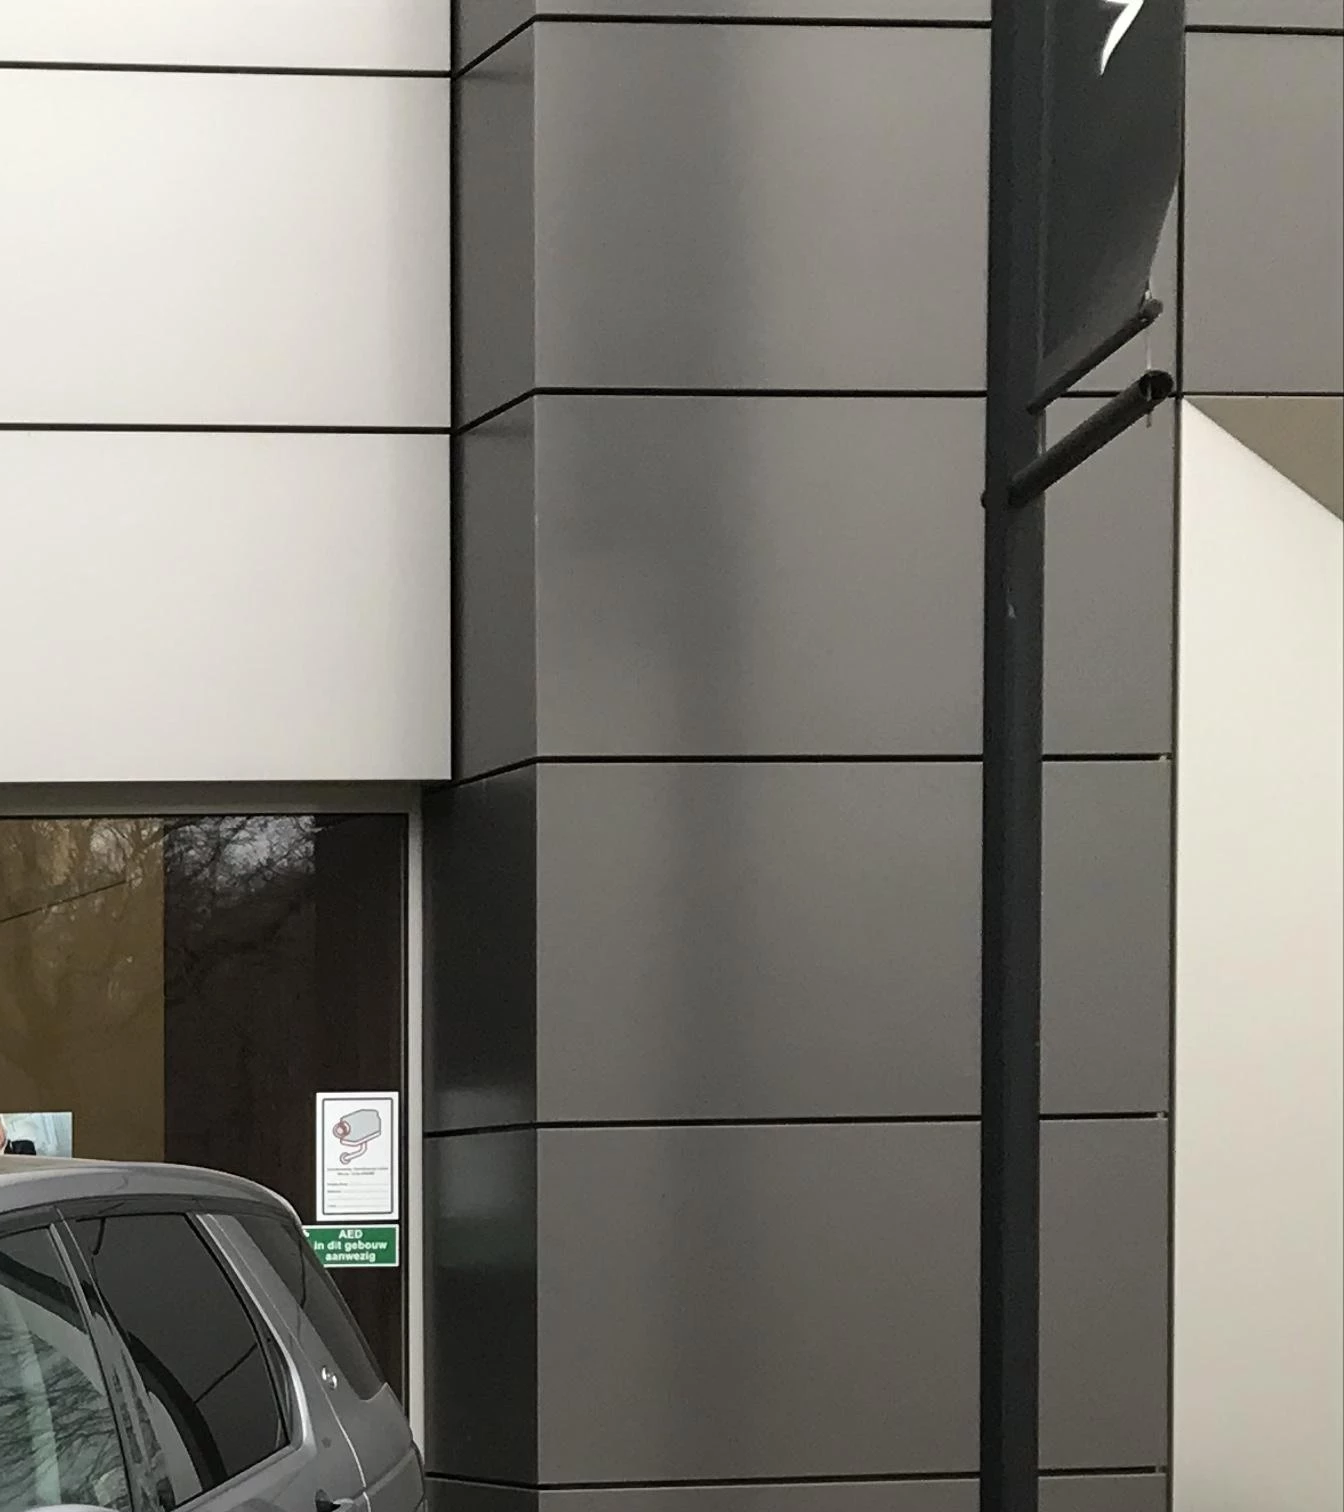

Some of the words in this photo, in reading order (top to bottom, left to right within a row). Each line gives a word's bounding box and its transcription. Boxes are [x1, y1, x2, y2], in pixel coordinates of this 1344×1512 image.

[338, 1229, 364, 1239] AED
[327, 1240, 342, 1250] dit
[344, 1240, 388, 1252] gebouw
[325, 1251, 376, 1262] aanwezig
